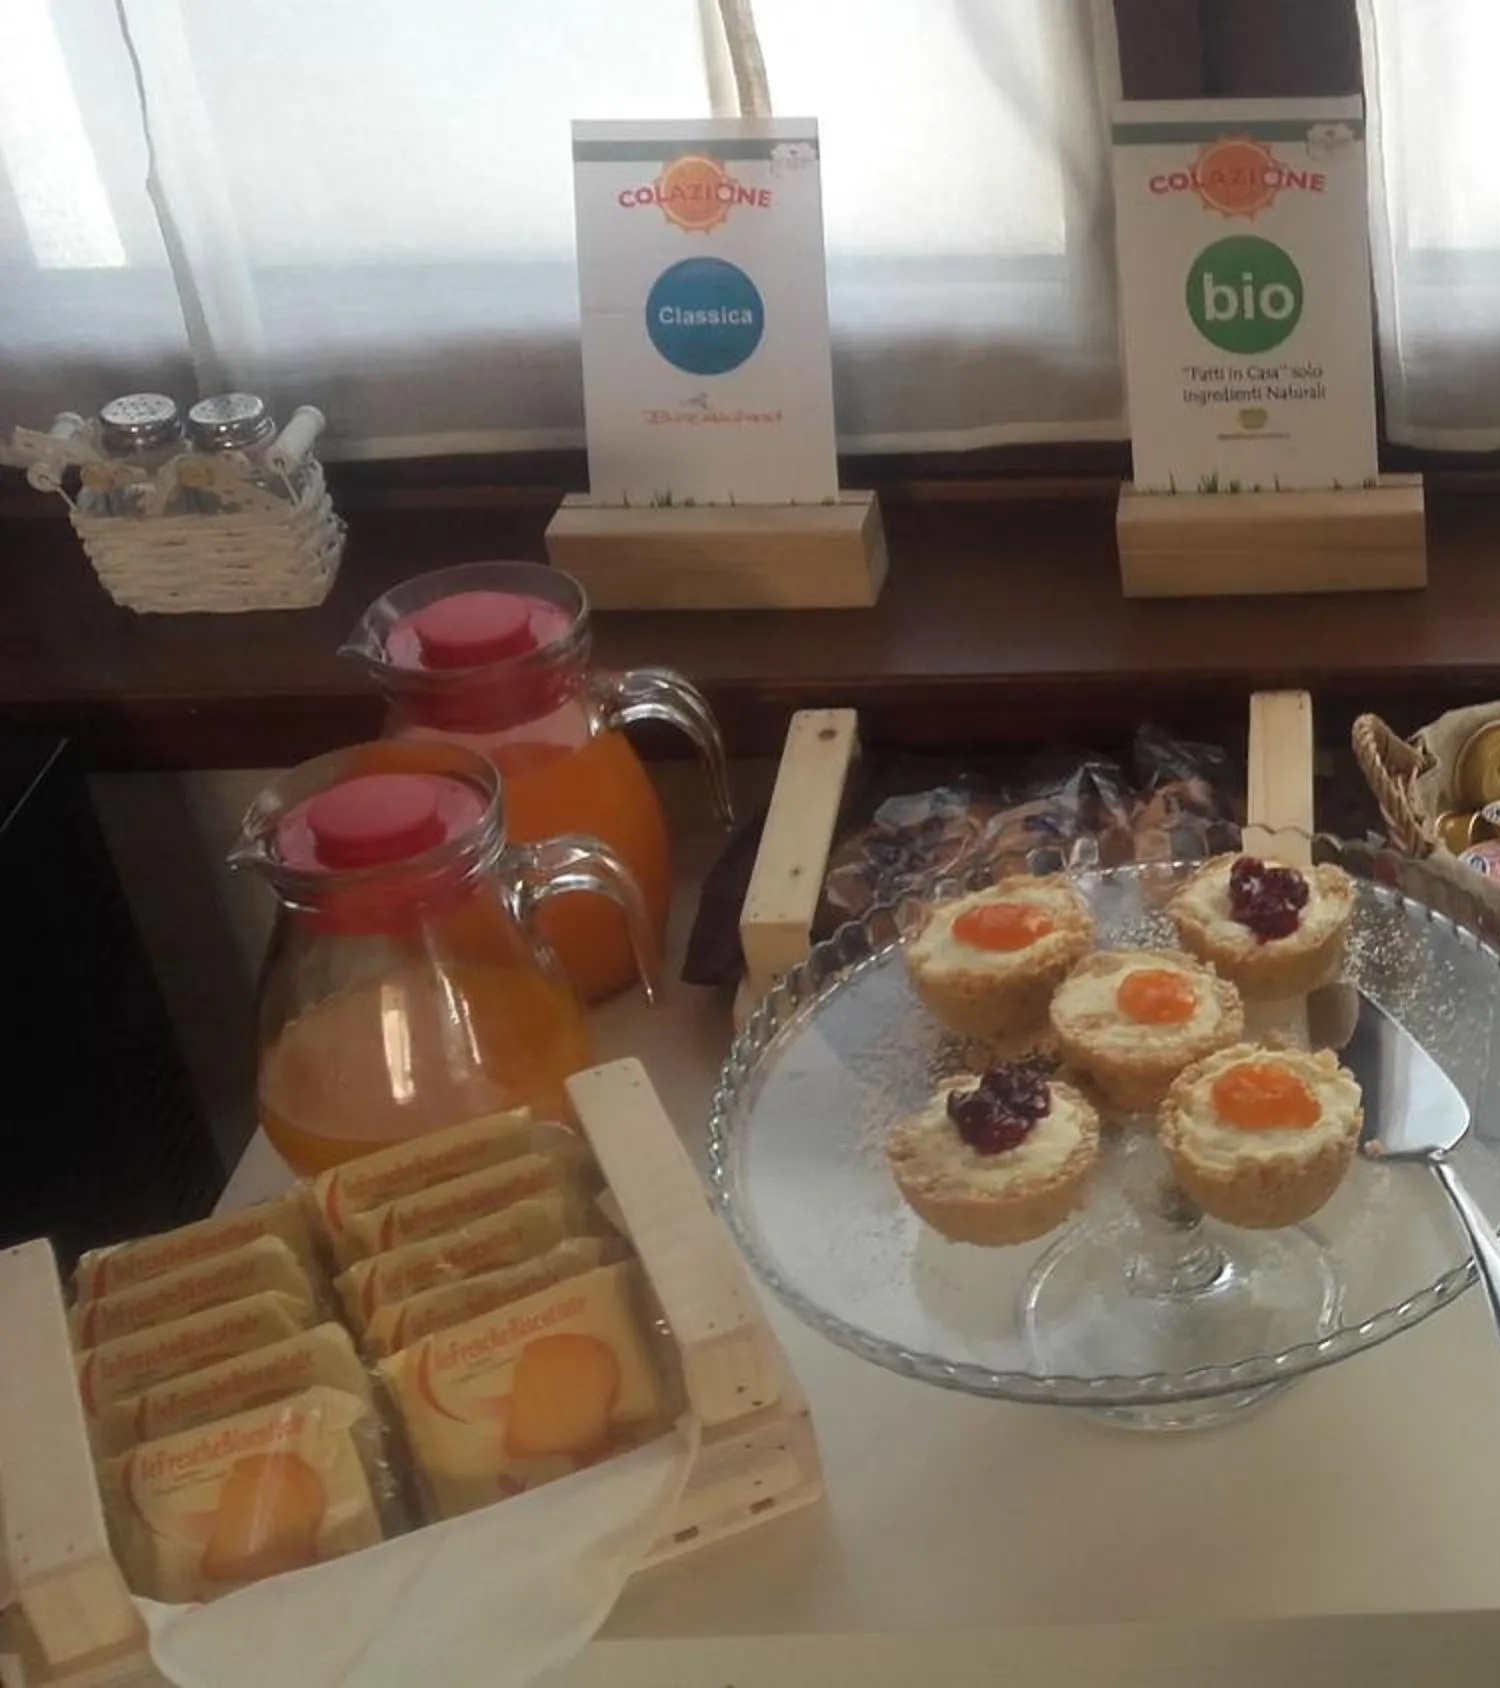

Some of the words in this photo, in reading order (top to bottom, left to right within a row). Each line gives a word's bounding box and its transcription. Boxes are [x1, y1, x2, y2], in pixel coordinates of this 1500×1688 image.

[1149, 165, 1327, 194] COLAZIONE
[618, 184, 773, 208] COLAZIONE
[1203, 271, 1296, 321] bio
[658, 305, 754, 326] Classica
[1292, 360, 1324, 380] solo
[1266, 381, 1327, 401] Naturali
